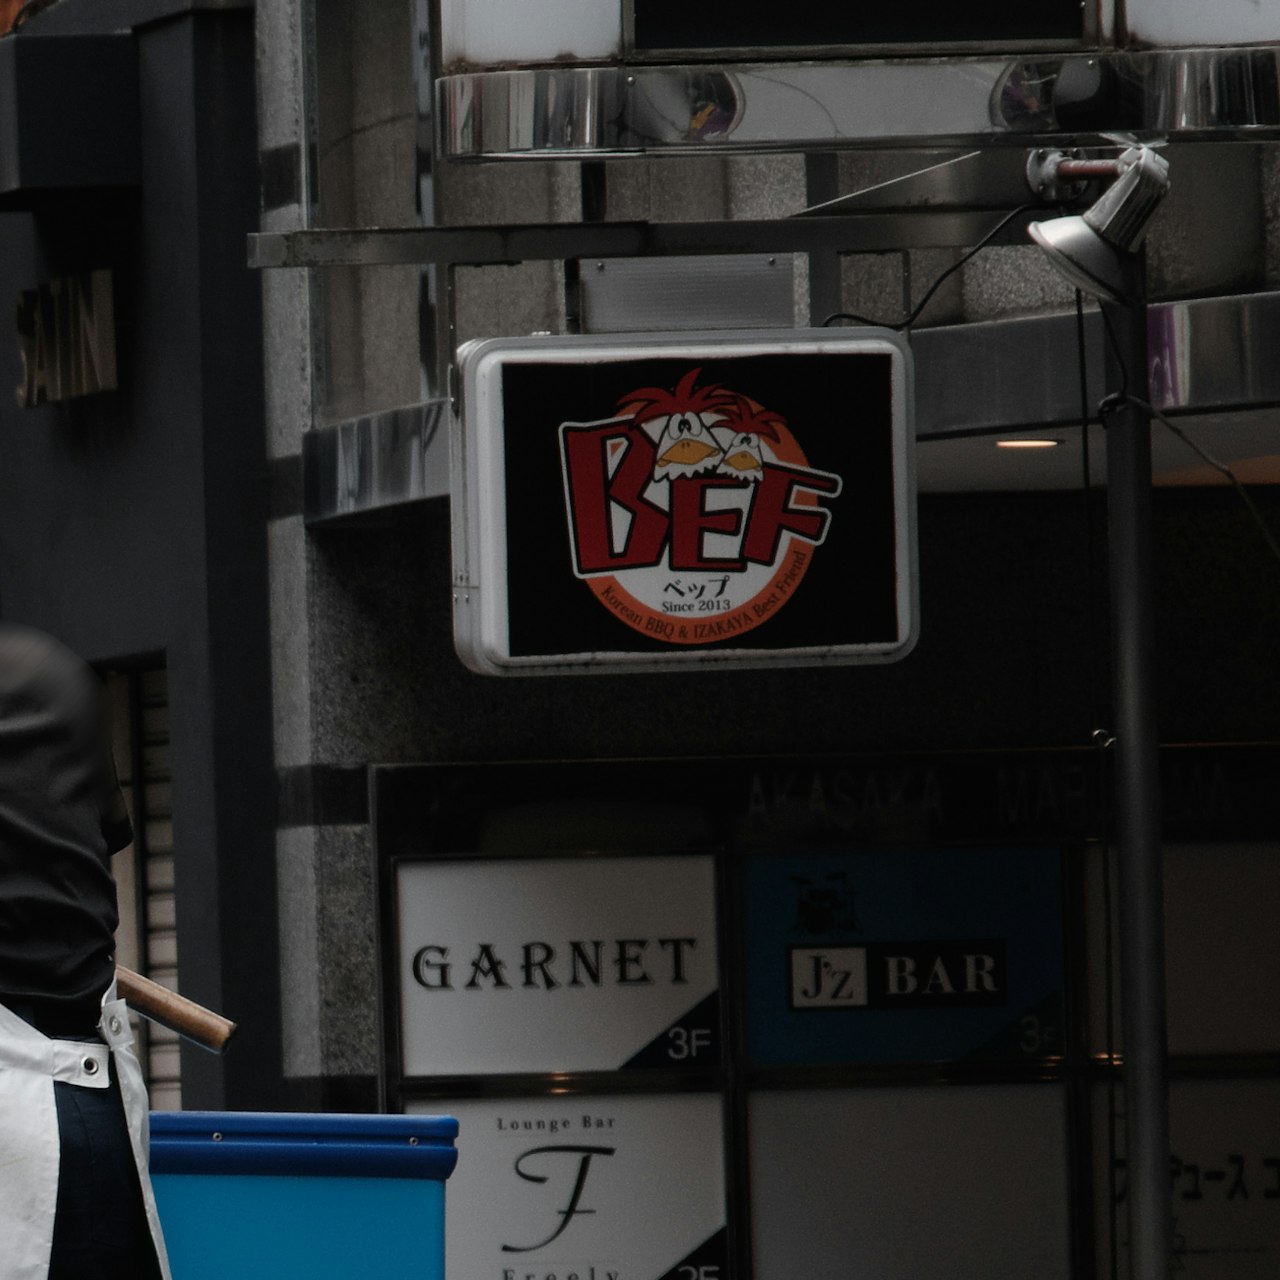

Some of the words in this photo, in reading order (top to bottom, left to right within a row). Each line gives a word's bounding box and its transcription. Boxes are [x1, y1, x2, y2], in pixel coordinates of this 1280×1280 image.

[560, 416, 841, 576] BEF
[600, 585, 643, 626] Korean
[645, 617, 675, 638] BBQ
[678, 625, 689, 638] &
[693, 613, 754, 639] IZAKAYA
[754, 594, 780, 618] Best
[778, 550, 807, 594] Friend
[661, 601, 696, 613] Since
[698, 599, 732, 612] 2013
[663, 575, 731, 600] ベップ
[412, 937, 699, 992] GARNET
[883, 953, 999, 996] BAR
[667, 1027, 712, 1059] 3F
[497, 1117, 571, 1133] Lounge
[583, 1115, 616, 1129] Bar
